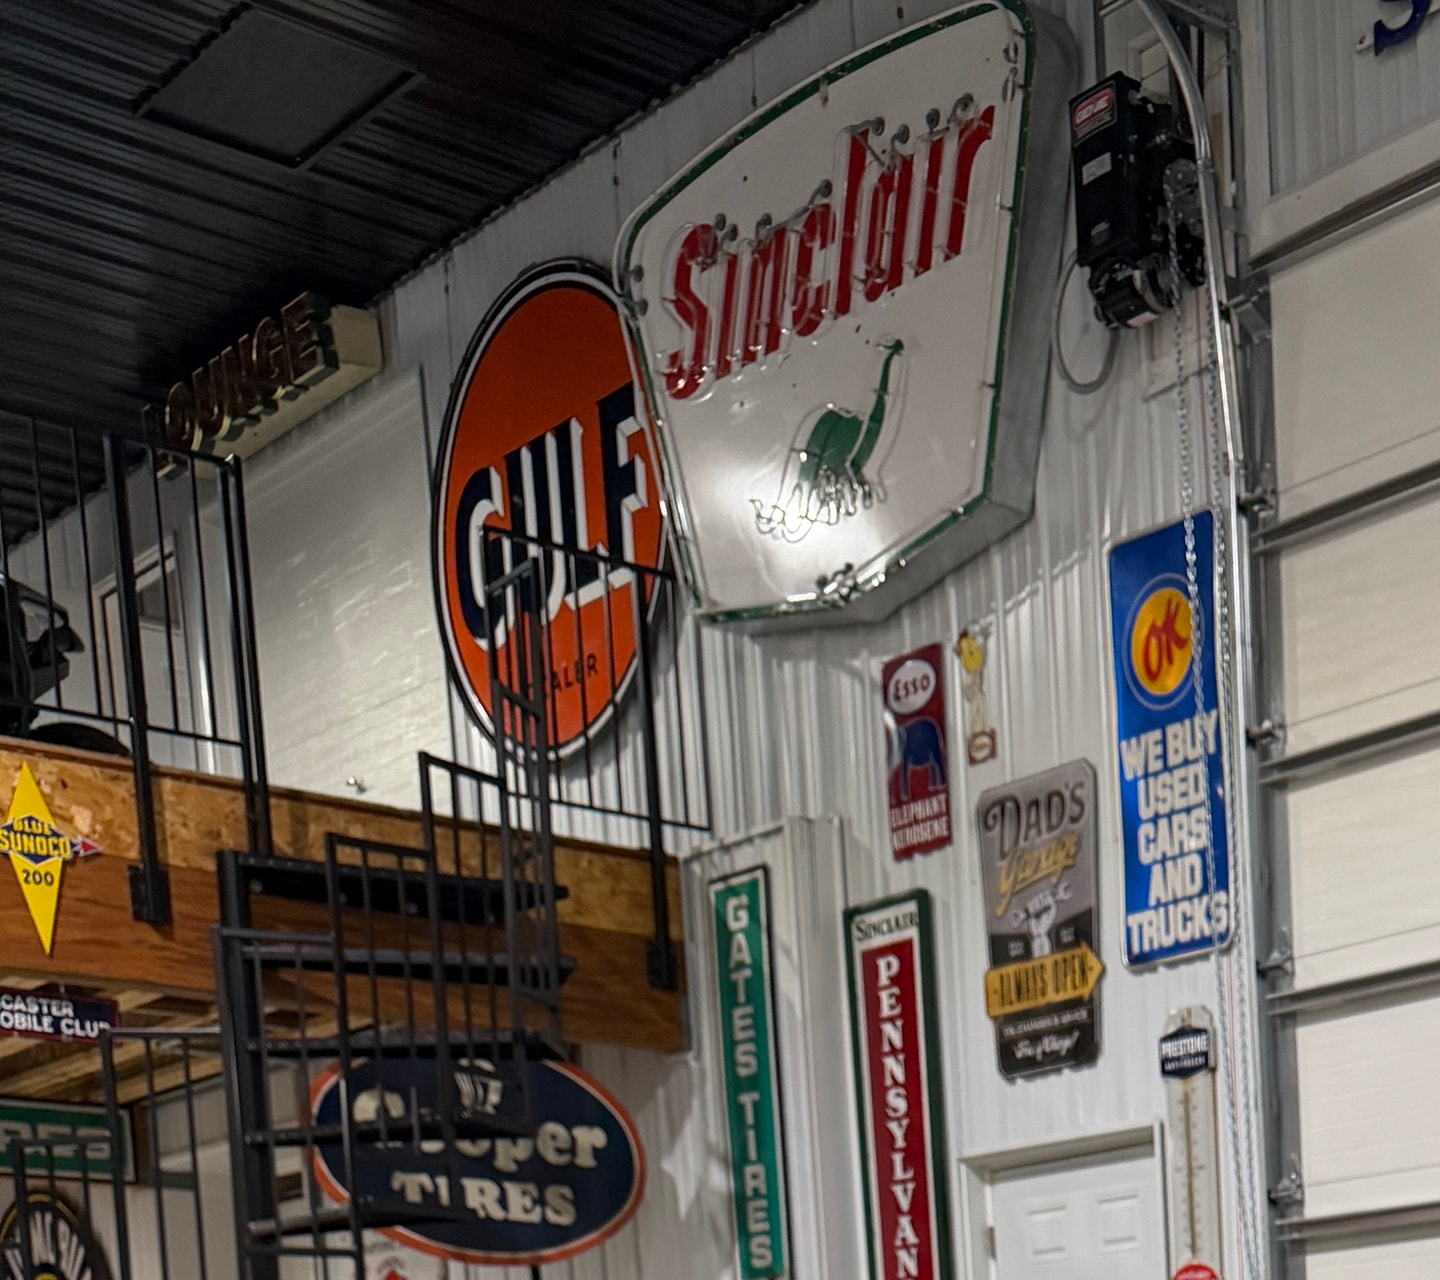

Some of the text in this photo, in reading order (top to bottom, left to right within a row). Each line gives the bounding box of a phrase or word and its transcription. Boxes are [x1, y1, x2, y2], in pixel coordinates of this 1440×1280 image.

[664, 104, 996, 400] Sinclair
[455, 379, 650, 651] GULF
[1144, 597, 1188, 683] OK
[1120, 709, 1219, 781] WE BUY
[984, 780, 1086, 864] DAD'S
[1138, 769, 1204, 820] USED
[0, 829, 73, 859] SUNOCO
[13, 818, 51, 836] BLUE
[1137, 809, 1208, 865] CARS
[22, 869, 54, 887] 200
[1148, 854, 1203, 907] AND
[1127, 889, 1229, 957] TRUCKS
[0, 993, 75, 1018] CASTER
[725, 894, 760, 1077] GATES
[998, 953, 1090, 1008] ALWAYS OPEN
[0, 1010, 55, 1034] OBILE
[391, 1171, 577, 1227] TIRES
[737, 1090, 774, 1269] TIRES
